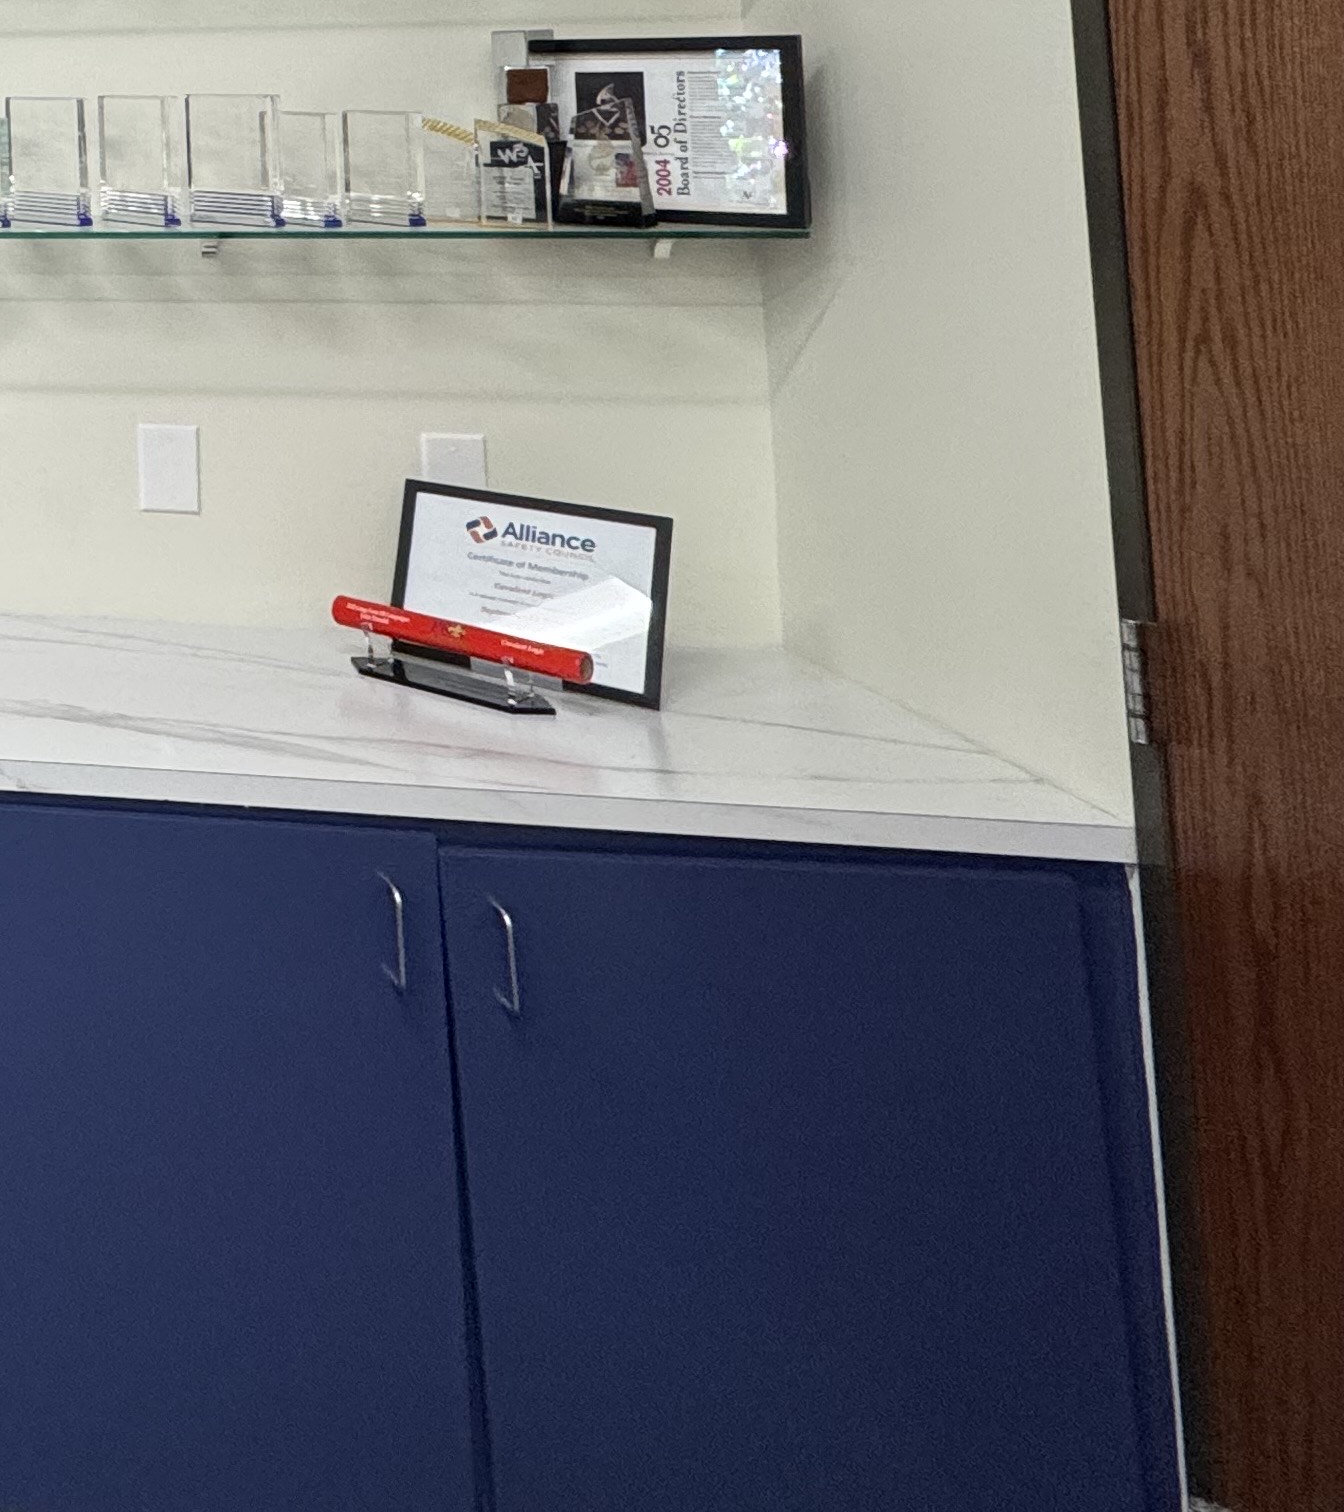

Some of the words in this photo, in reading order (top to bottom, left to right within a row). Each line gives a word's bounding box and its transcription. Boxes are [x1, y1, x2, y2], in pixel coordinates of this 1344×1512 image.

[673, 70, 688, 134] Directors
[649, 124, 672, 148] 05
[674, 137, 688, 153] of
[654, 159, 672, 197] 2004
[674, 157, 691, 196] Board
[501, 521, 596, 553] Alliance
[467, 551, 514, 567] Certificate
[528, 561, 590, 582] Membership
